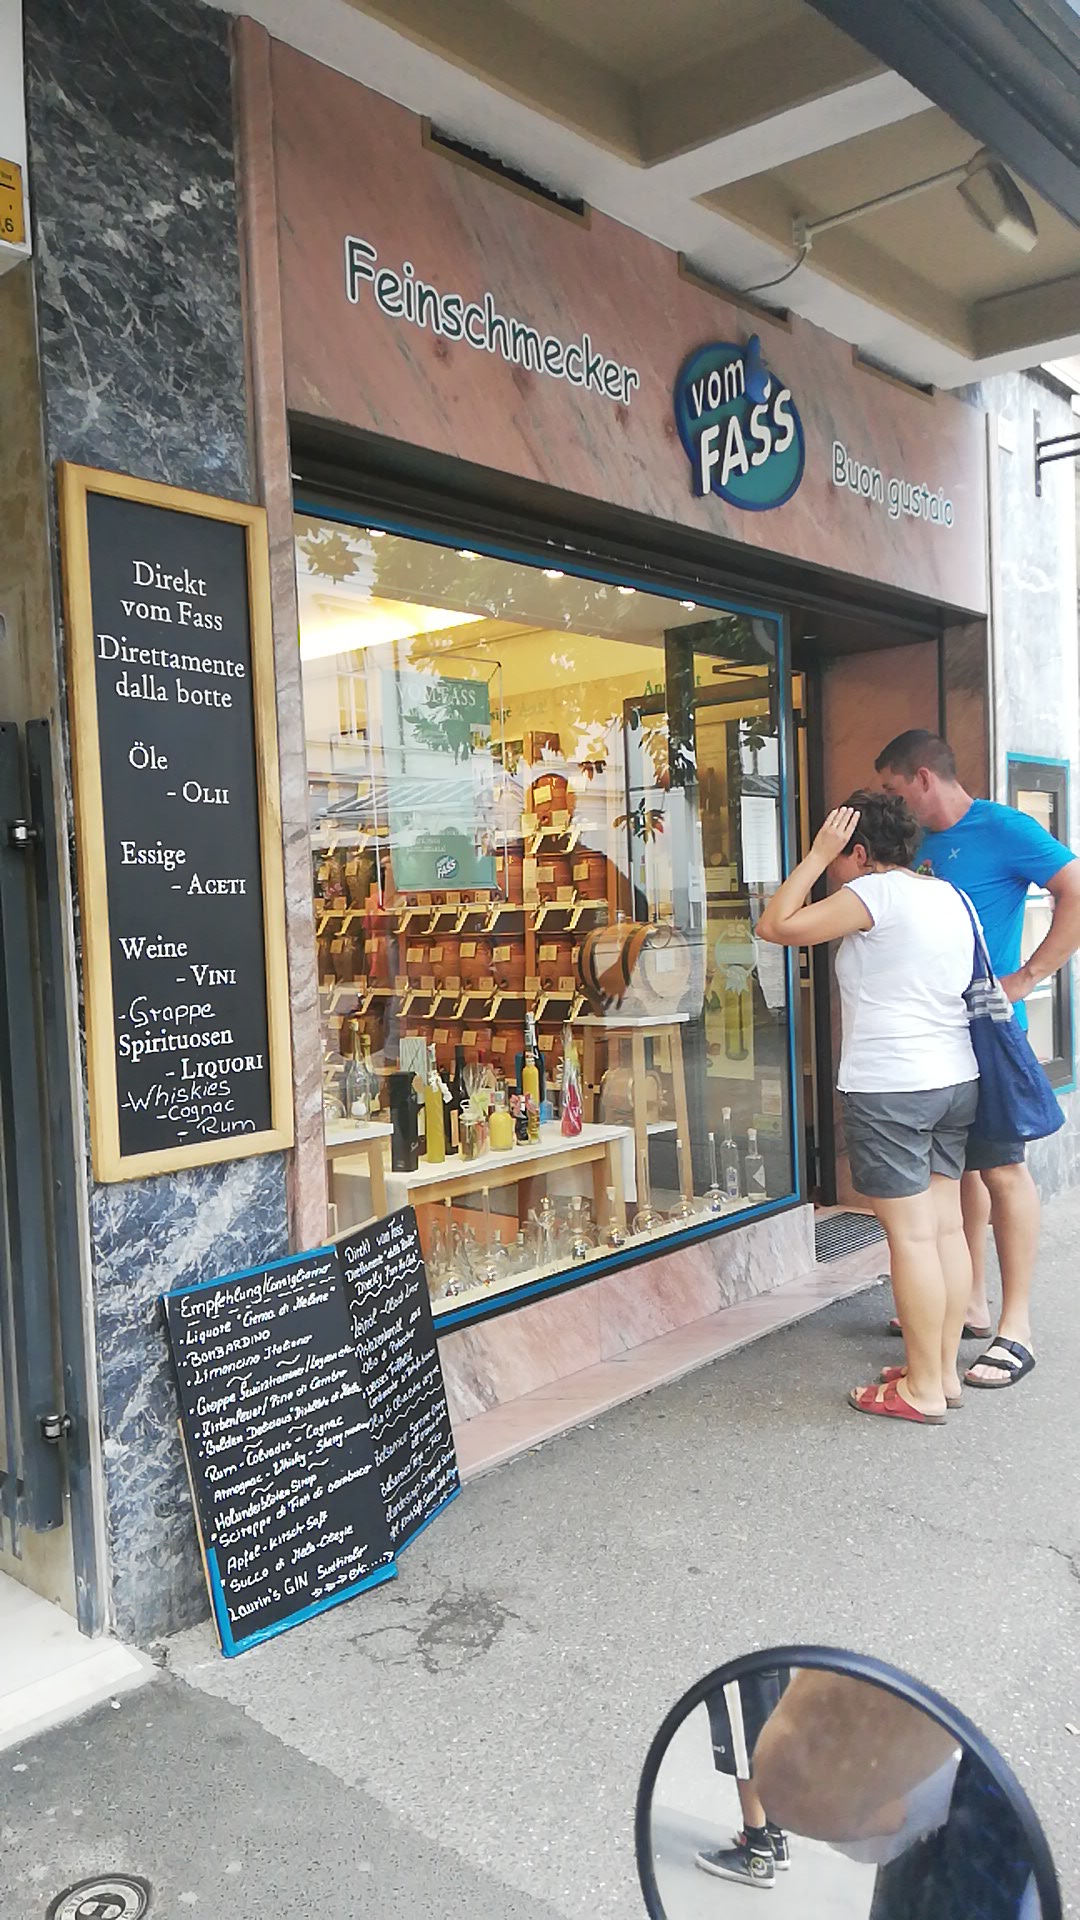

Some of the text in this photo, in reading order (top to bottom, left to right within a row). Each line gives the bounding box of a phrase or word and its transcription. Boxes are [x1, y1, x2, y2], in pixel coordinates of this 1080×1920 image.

[344, 234, 640, 406] Feinschmecker
[692, 359, 746, 418] vom
[700, 389, 795, 495] FASS
[832, 441, 954, 528] Buon gustaio
[132, 560, 207, 597] Direkt
[120, 598, 223, 631] vom Fass
[96, 634, 246, 678] Direttamente
[115, 671, 233, 708] dalla botte
[128, 741, 168, 770] Öle
[120, 840, 186, 871] Essige
[186, 873, 246, 895] ACETI
[119, 934, 188, 960] Weine
[189, 964, 237, 986] VINI
[118, 1028, 234, 1063] Spirituosen
[181, 1054, 264, 1081] LIQUORI
[196, 1116, 256, 1135] Rum
[205, 1465, 237, 1482] Rum
[284, 1571, 309, 1595] GIN
